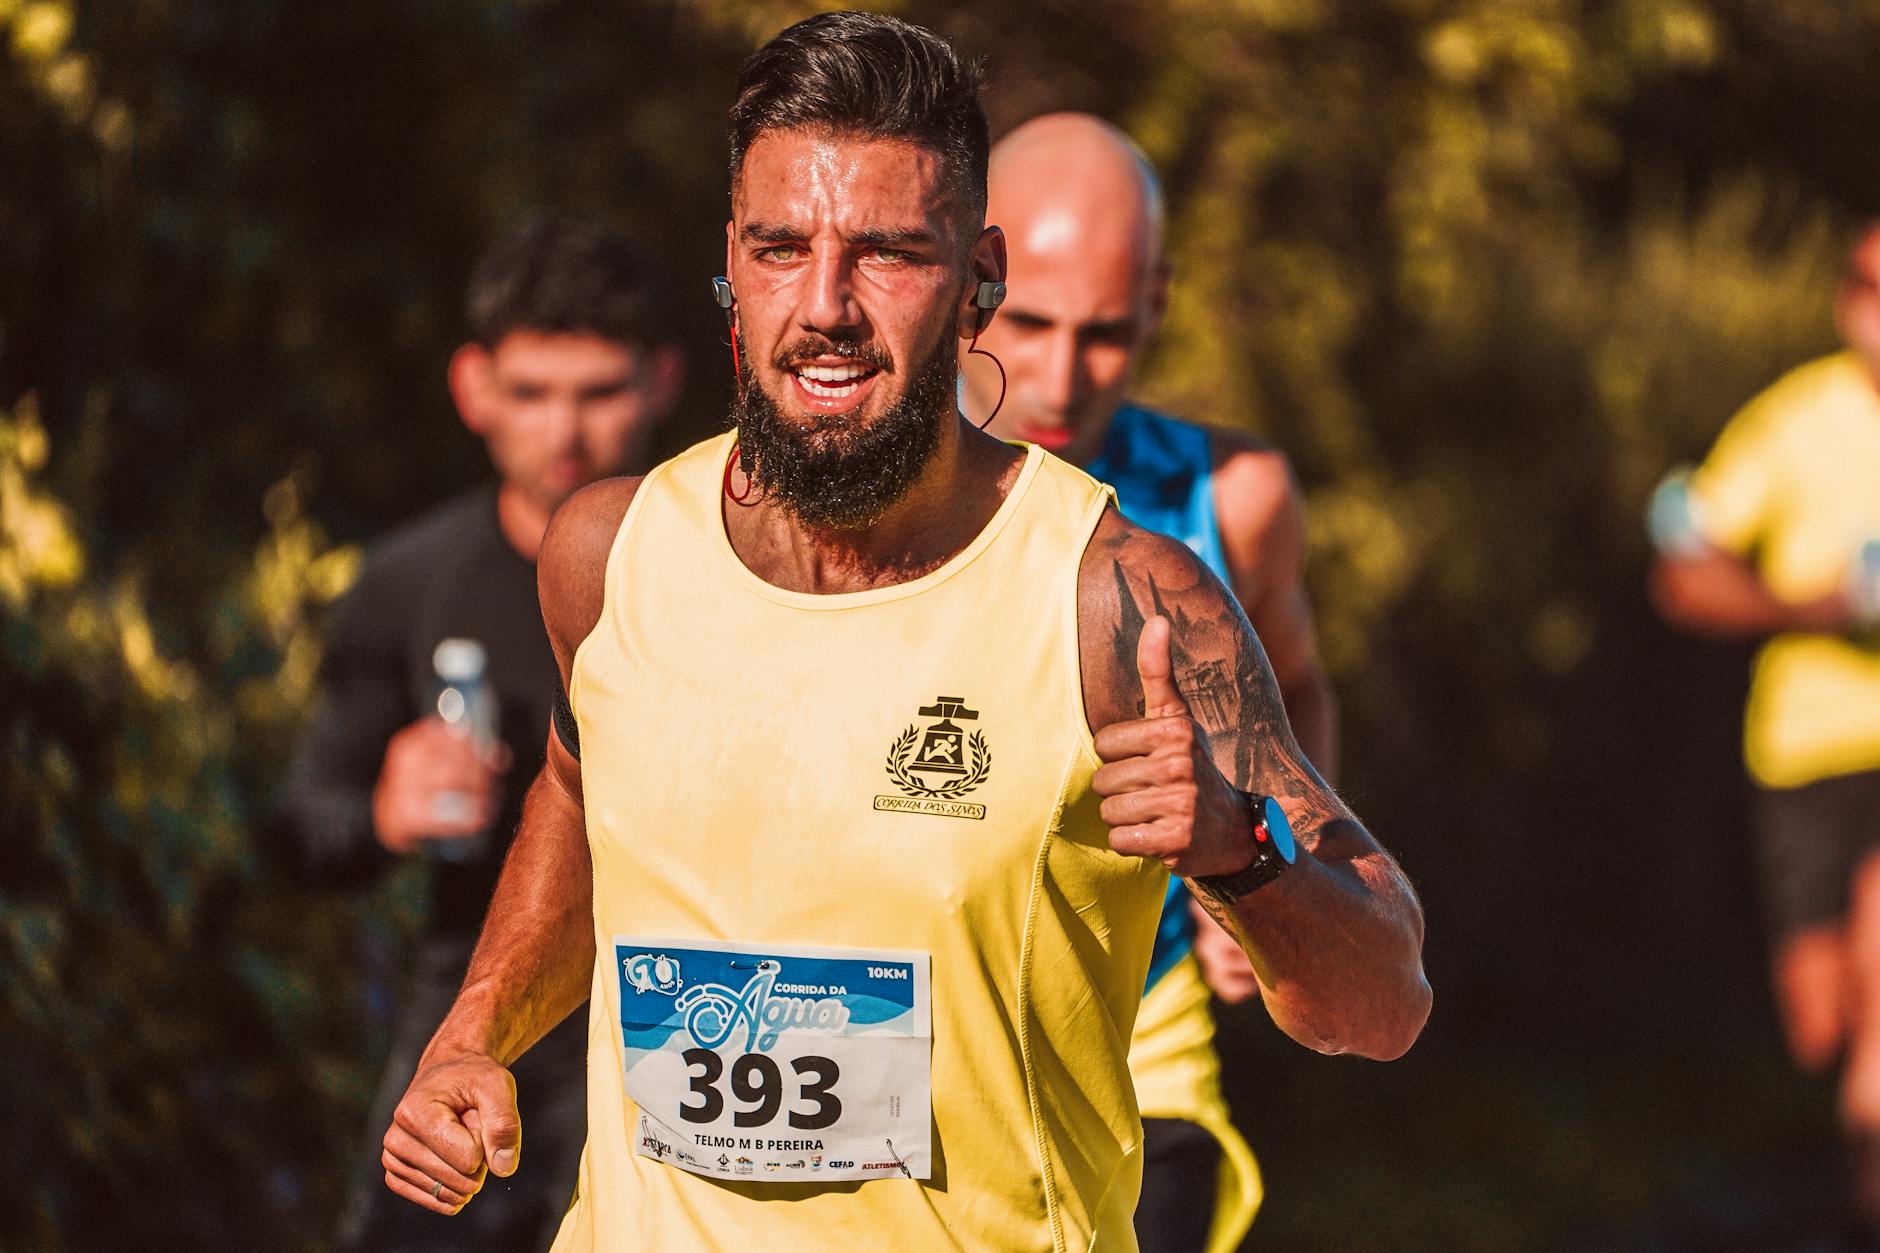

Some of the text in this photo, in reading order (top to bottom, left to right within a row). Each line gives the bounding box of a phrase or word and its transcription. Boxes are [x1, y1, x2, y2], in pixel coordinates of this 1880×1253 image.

[876, 798, 983, 817] CORRIDA DOS SINOS
[868, 966, 909, 980] 10KM
[774, 982, 848, 996] CORRIDA DA
[679, 1048, 842, 1130] 393
[694, 1134, 824, 1151] TELMO M B PEREIRA
